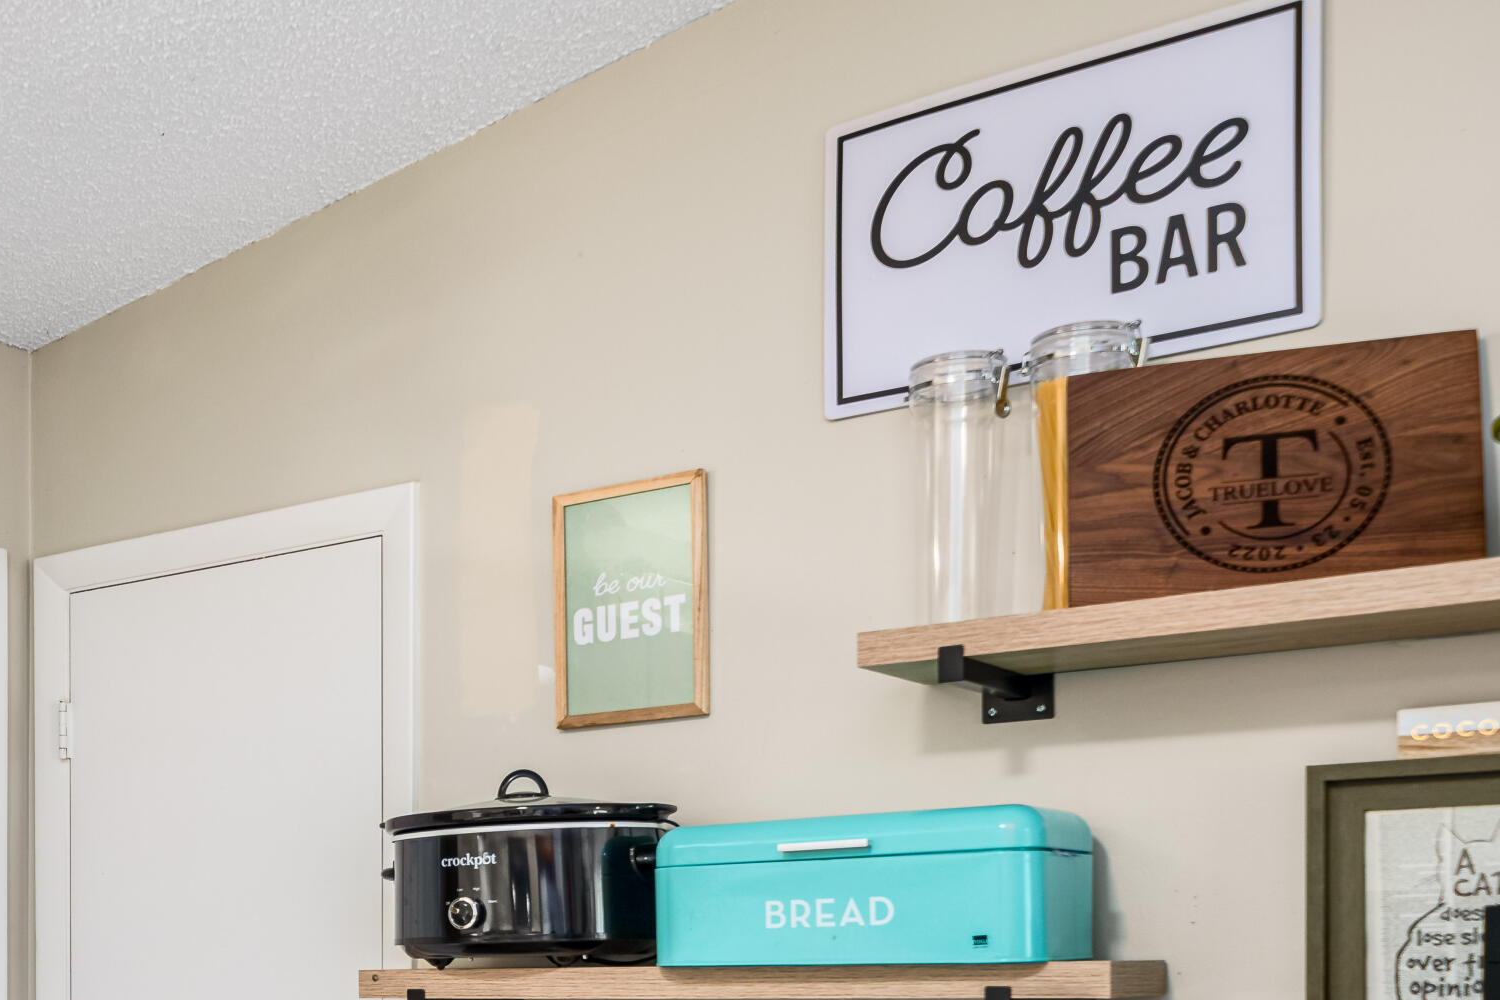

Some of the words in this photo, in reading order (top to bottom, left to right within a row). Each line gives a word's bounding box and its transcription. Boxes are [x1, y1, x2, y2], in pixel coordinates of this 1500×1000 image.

[869, 112, 1250, 270] Coffee
[1110, 201, 1248, 294] BAR
[1174, 462, 1208, 520] JACOB
[1193, 393, 1326, 443] CHARLOTTE
[1207, 476, 1334, 503] TRUELOVE
[593, 571, 619, 597] be
[626, 572, 668, 593] our
[573, 593, 687, 646] GUEST
[440, 851, 498, 870] crockpot
[1454, 848, 1477, 876] A
[764, 896, 895, 930] BREAD
[1416, 929, 1455, 946] lose
[1406, 955, 1456, 972] over
